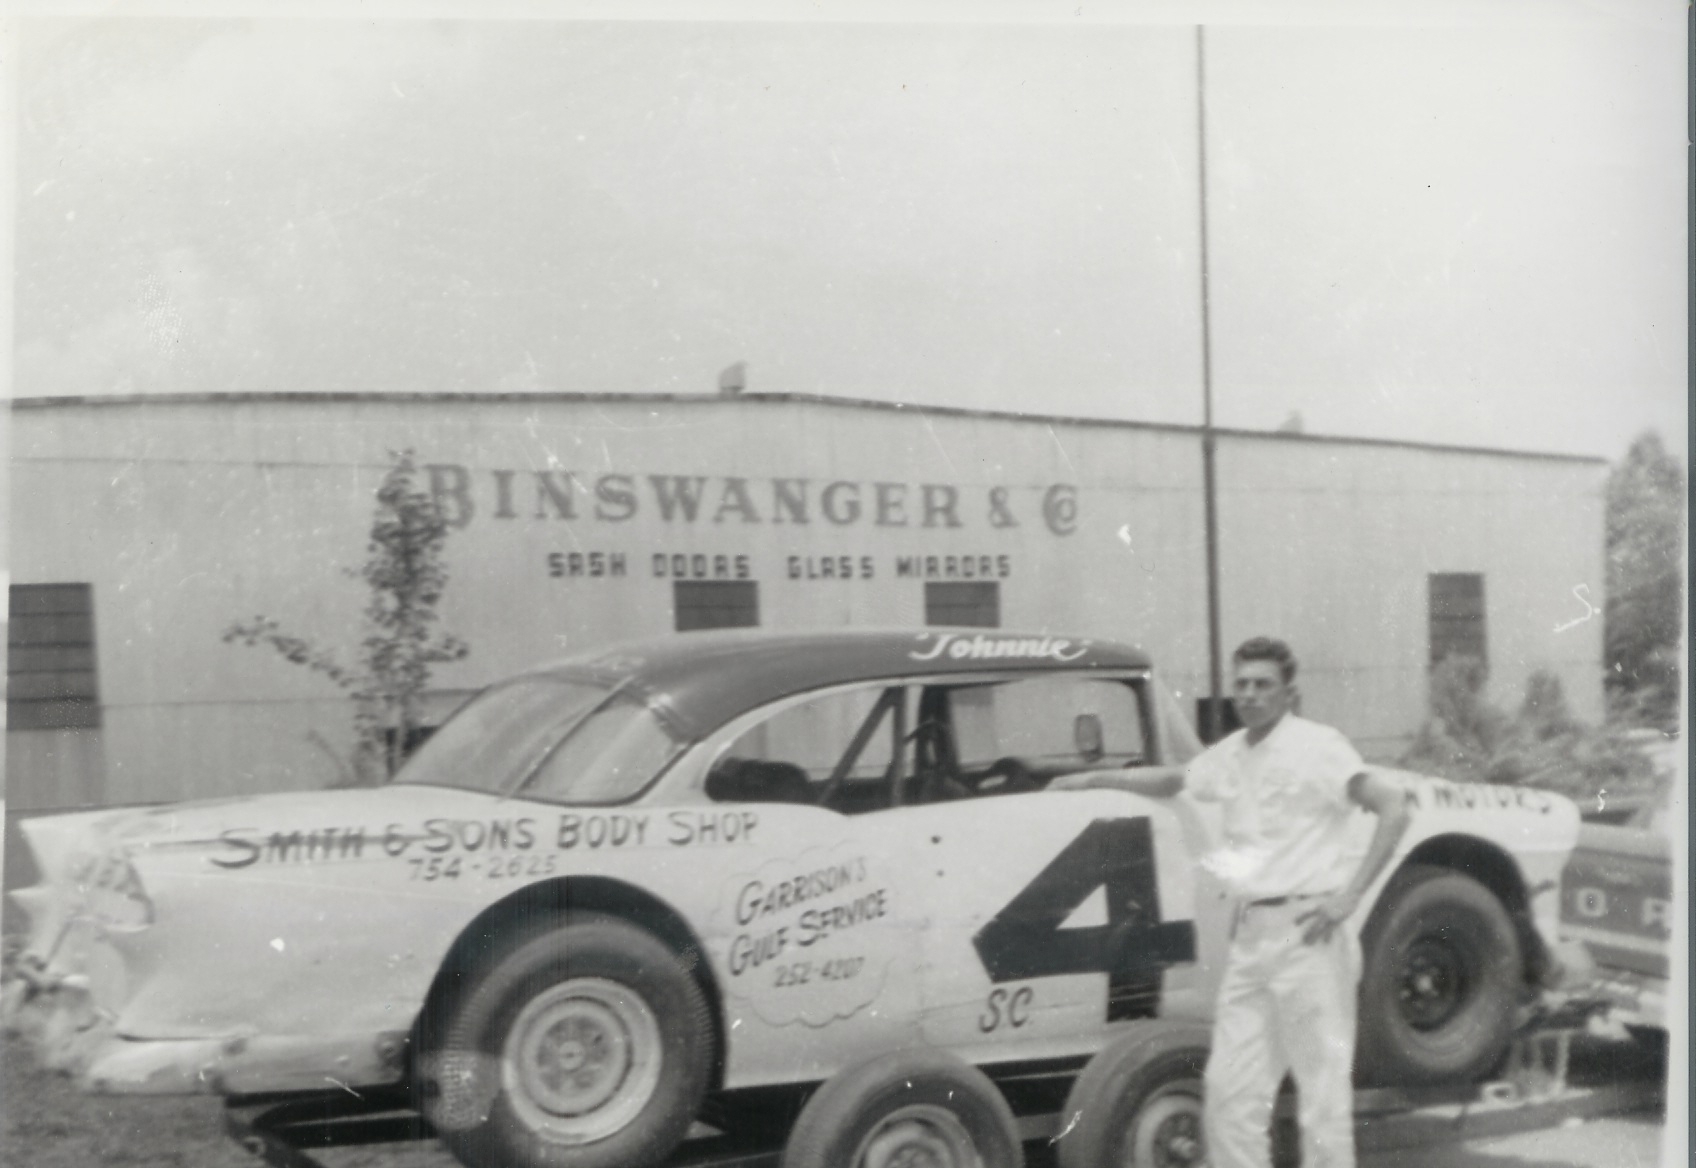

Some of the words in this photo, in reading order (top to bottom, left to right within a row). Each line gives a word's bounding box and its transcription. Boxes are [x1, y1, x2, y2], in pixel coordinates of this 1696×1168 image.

[423, 463, 963, 529] BINSWANGER
[987, 484, 1020, 529] &
[547, 551, 628, 578] SASH
[651, 552, 751, 580] DOORS
[786, 553, 876, 581] GLASS
[894, 553, 1012, 581] MIRRORS
[208, 826, 367, 870] SMITH
[422, 817, 537, 854] SONS
[556, 813, 652, 850] BODY
[666, 810, 760, 846] SHOP
[728, 926, 790, 977] GULF
[796, 887, 887, 948] SERVICE
[971, 815, 1197, 1024] 4
